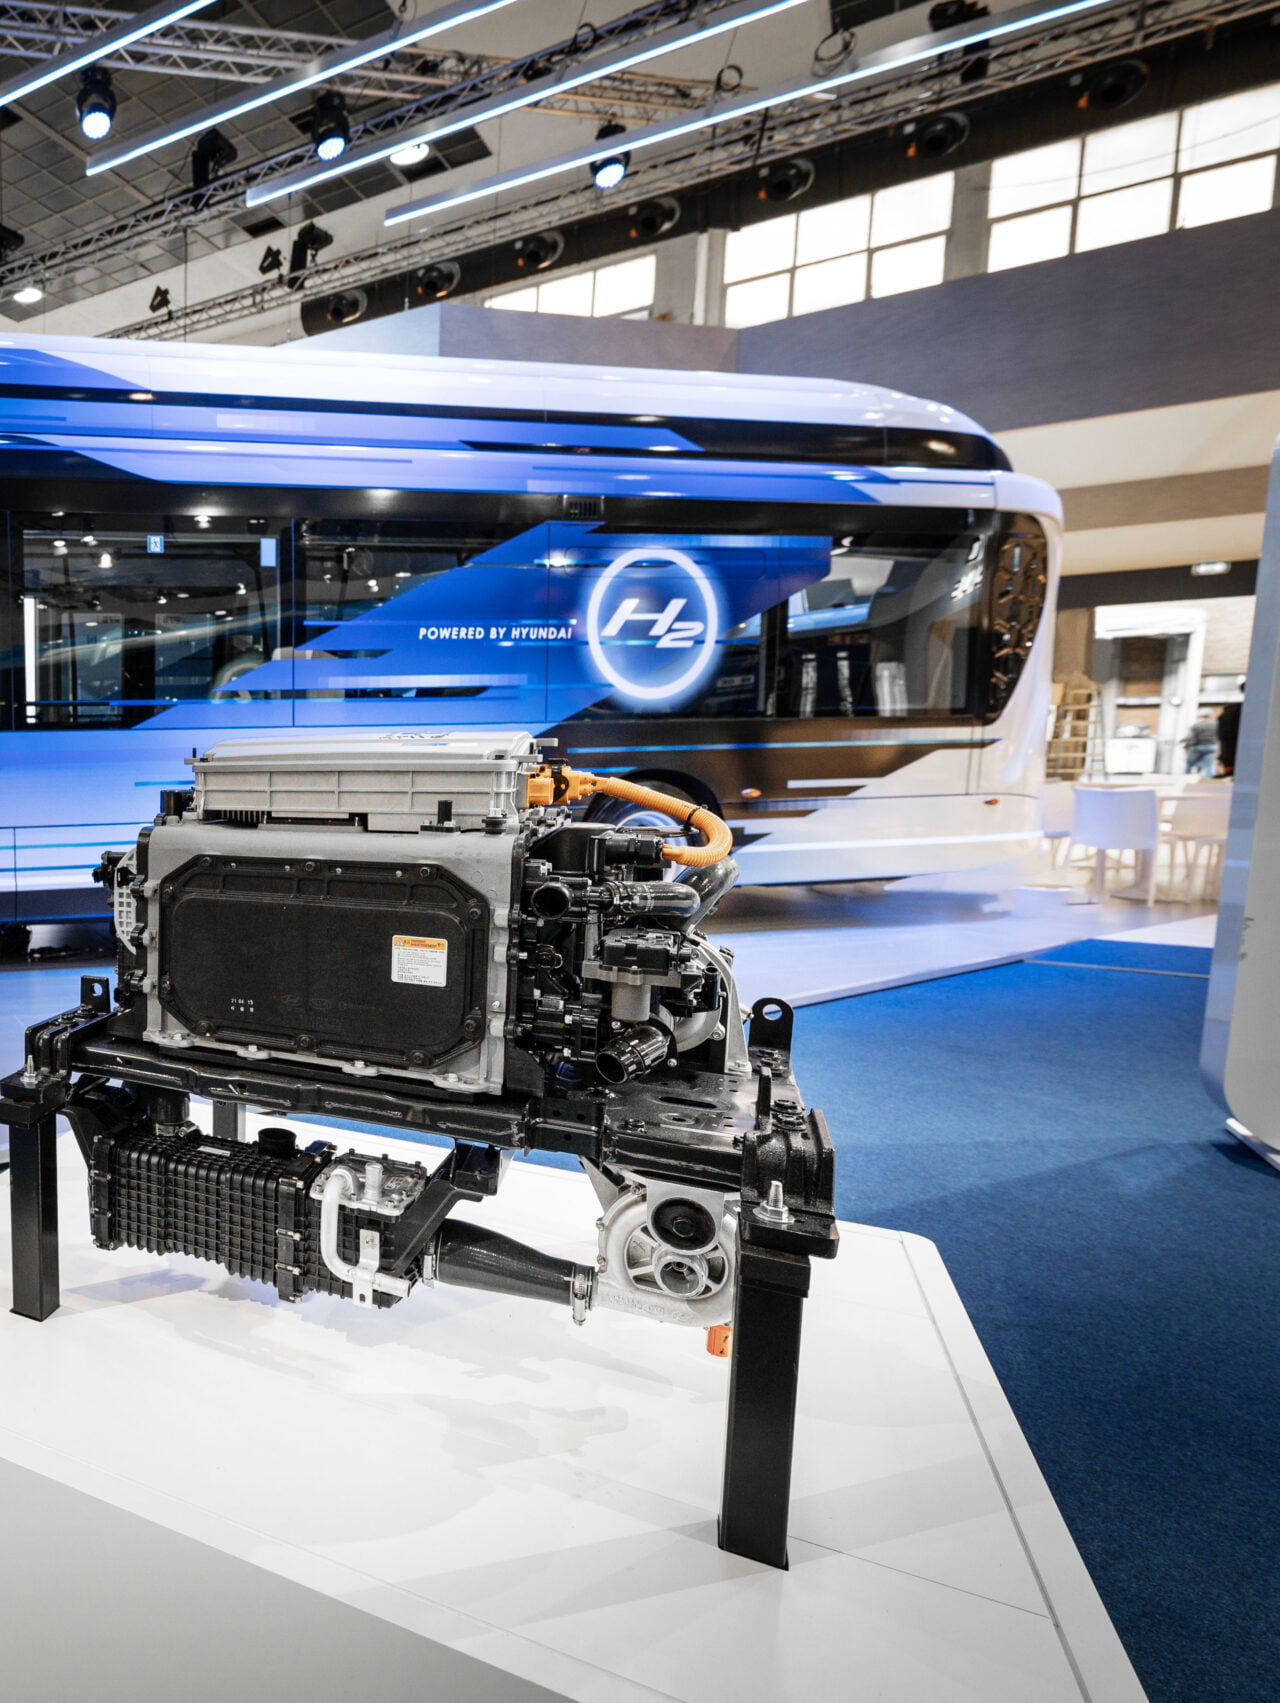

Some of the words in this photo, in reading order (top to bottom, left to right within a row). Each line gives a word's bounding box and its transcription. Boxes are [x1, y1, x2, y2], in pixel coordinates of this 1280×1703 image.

[419, 627, 484, 640] POWERED
[489, 627, 507, 639] BY
[511, 627, 572, 639] HYUNDAI
[600, 598, 705, 648] H2
